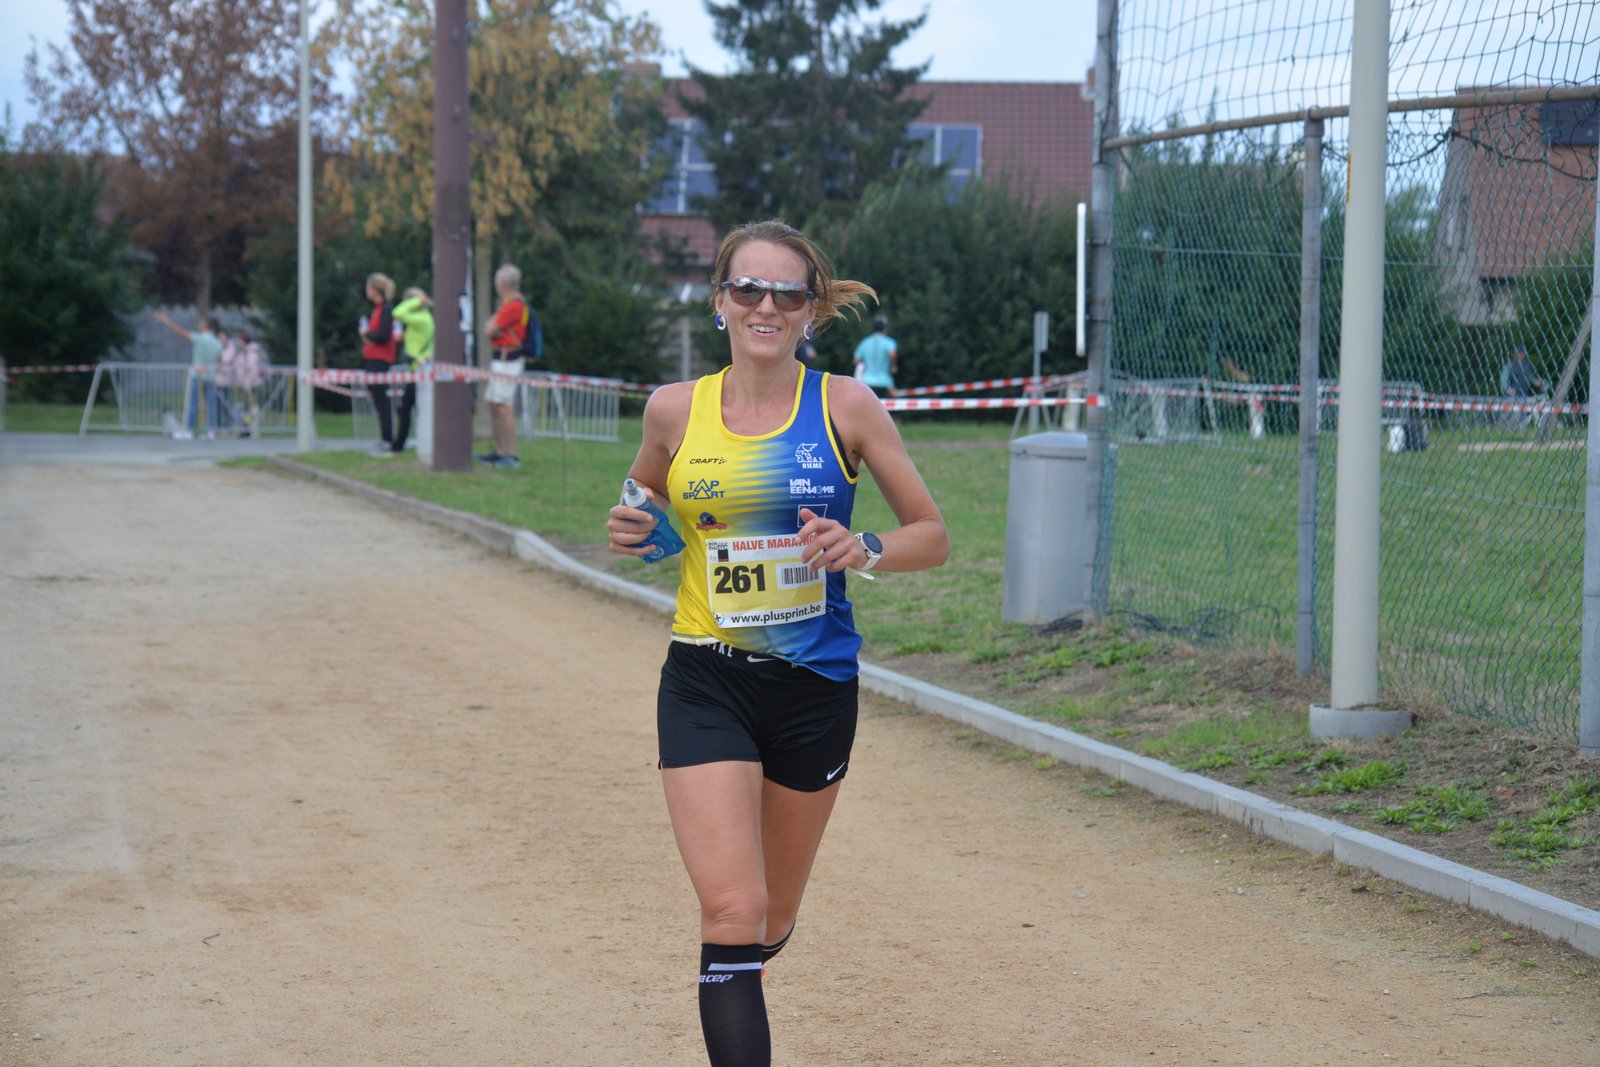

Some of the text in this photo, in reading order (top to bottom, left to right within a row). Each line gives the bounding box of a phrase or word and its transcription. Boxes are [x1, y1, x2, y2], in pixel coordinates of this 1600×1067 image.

[789, 479, 811, 487] VAN
[732, 540, 764, 551] HALVE
[713, 563, 766, 594] 261
[730, 604, 821, 624] www.plusprint.be
